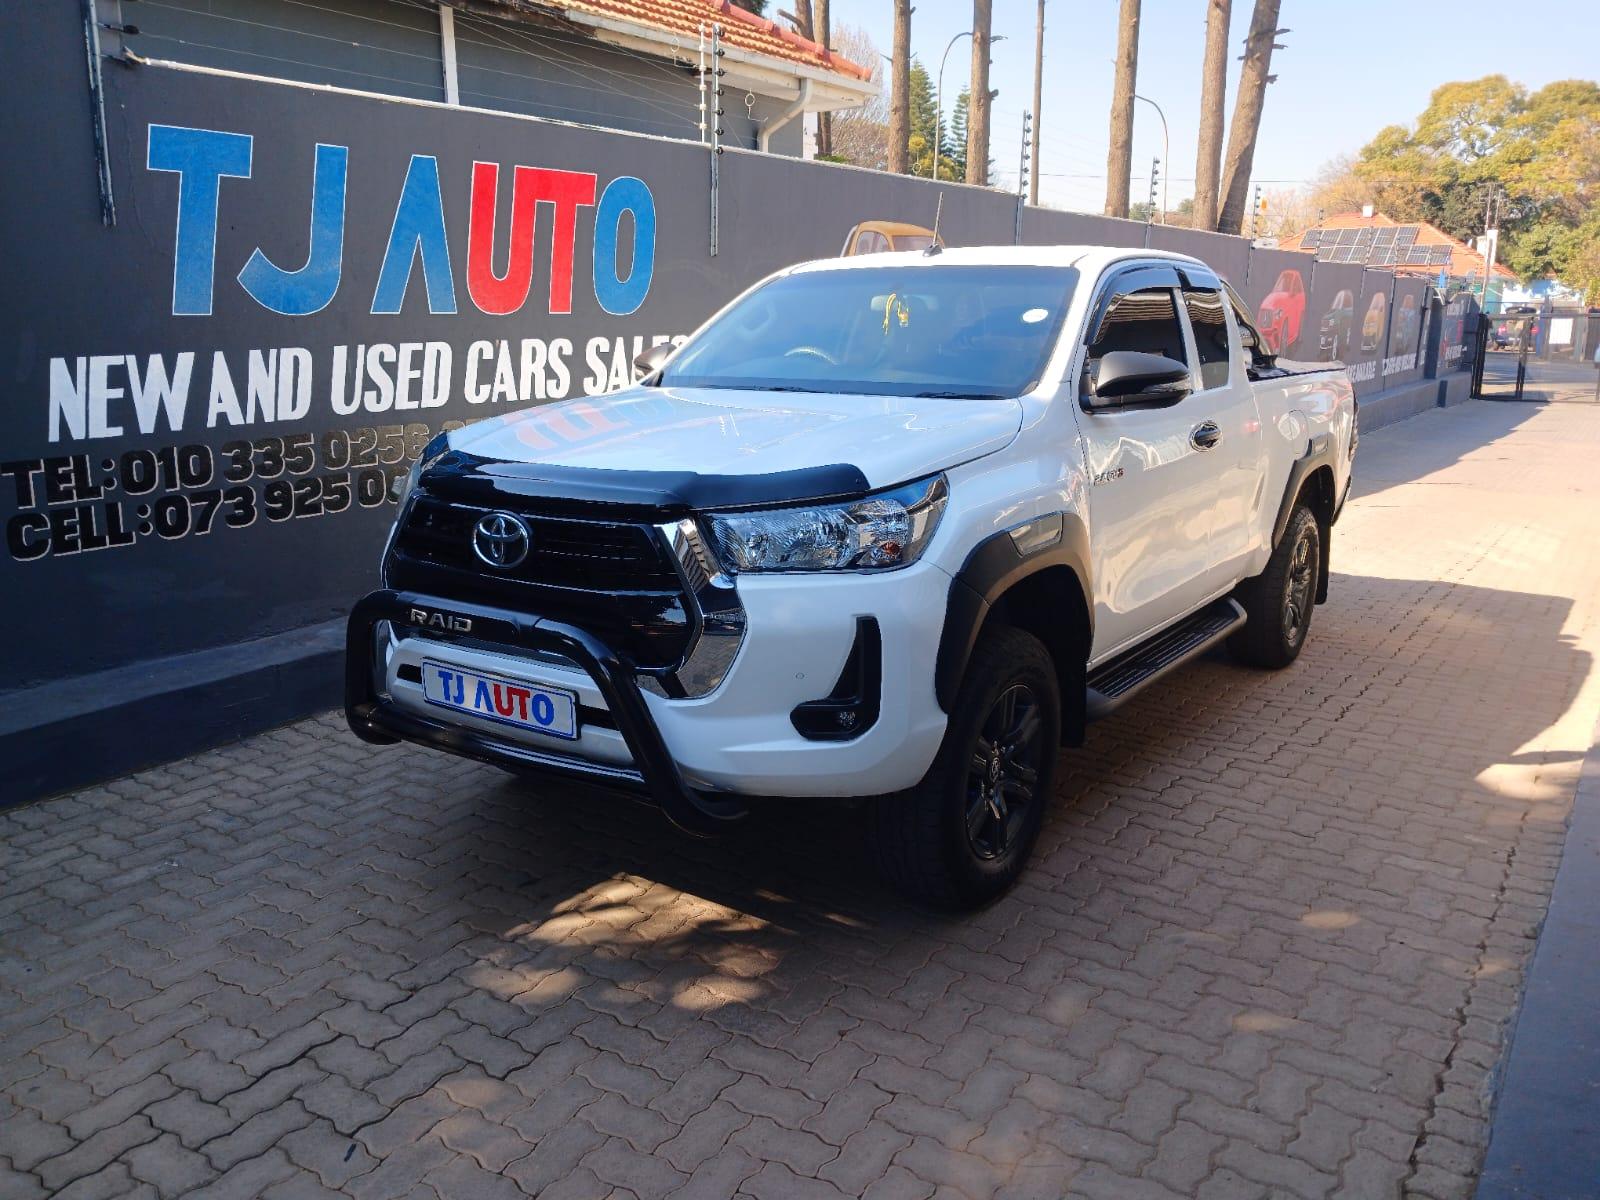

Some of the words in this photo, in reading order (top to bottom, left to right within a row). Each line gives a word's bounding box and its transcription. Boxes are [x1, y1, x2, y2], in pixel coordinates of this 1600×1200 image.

[147, 124, 348, 315] TJ
[370, 154, 656, 315] AUTO
[48, 351, 195, 442] NEW
[207, 346, 313, 428] AND
[330, 340, 452, 415] USED
[464, 338, 573, 404] CARS
[222, 432, 315, 483] 335
[264, 472, 352, 522] 925
[410, 608, 472, 632] RAID
[438, 671, 465, 705] TJ
[474, 680, 555, 726] AUTO
